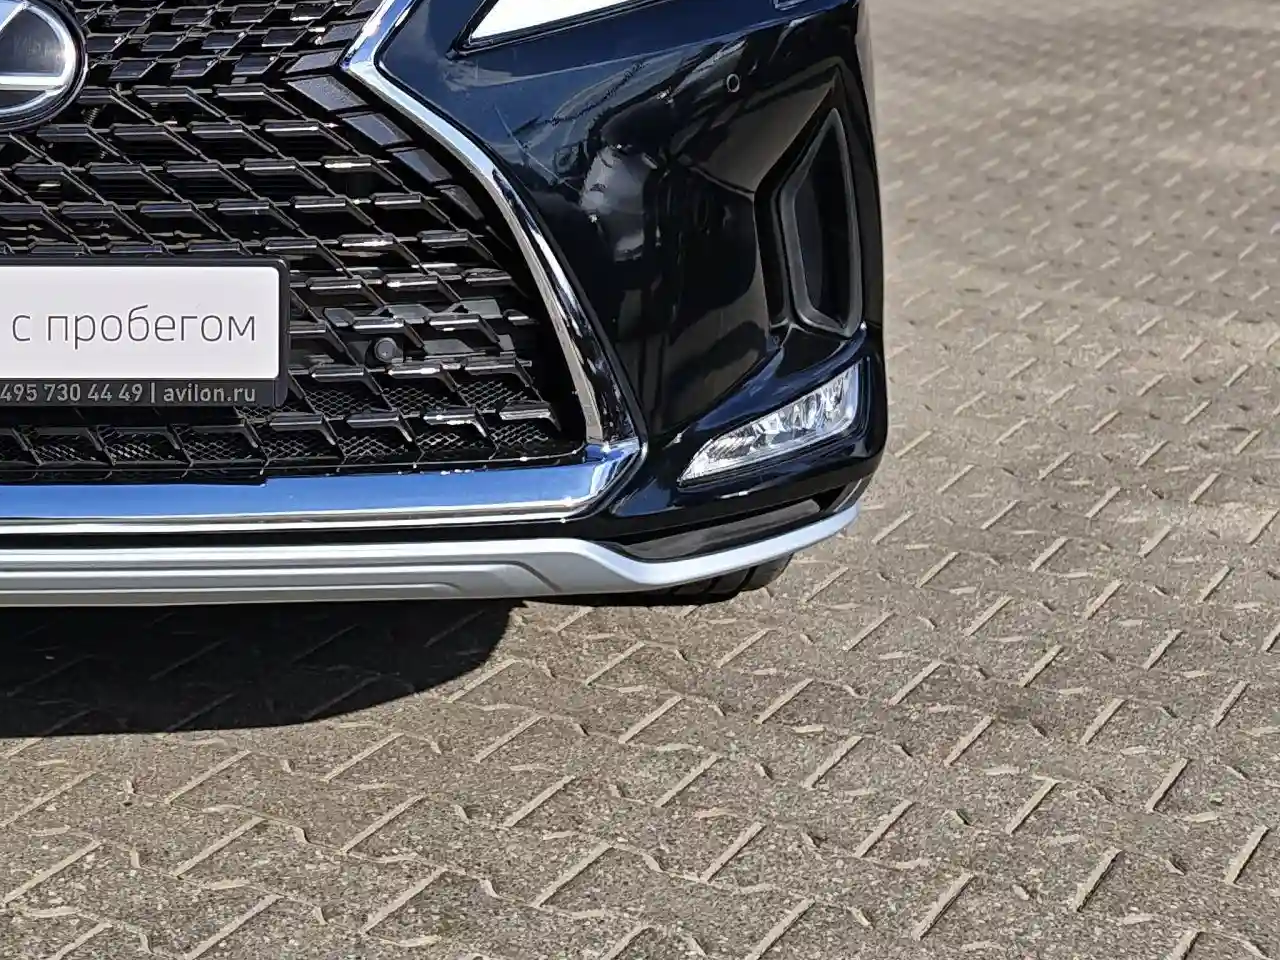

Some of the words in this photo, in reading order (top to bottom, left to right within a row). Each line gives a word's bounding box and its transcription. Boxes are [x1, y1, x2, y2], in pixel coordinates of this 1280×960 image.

[12, 314, 31, 342] с
[47, 304, 256, 350] пробегом
[0, 383, 38, 402] 495
[44, 383, 81, 402] 730
[87, 383, 112, 402] 44
[118, 383, 143, 402] 49
[163, 382, 256, 403] avilon.ru
